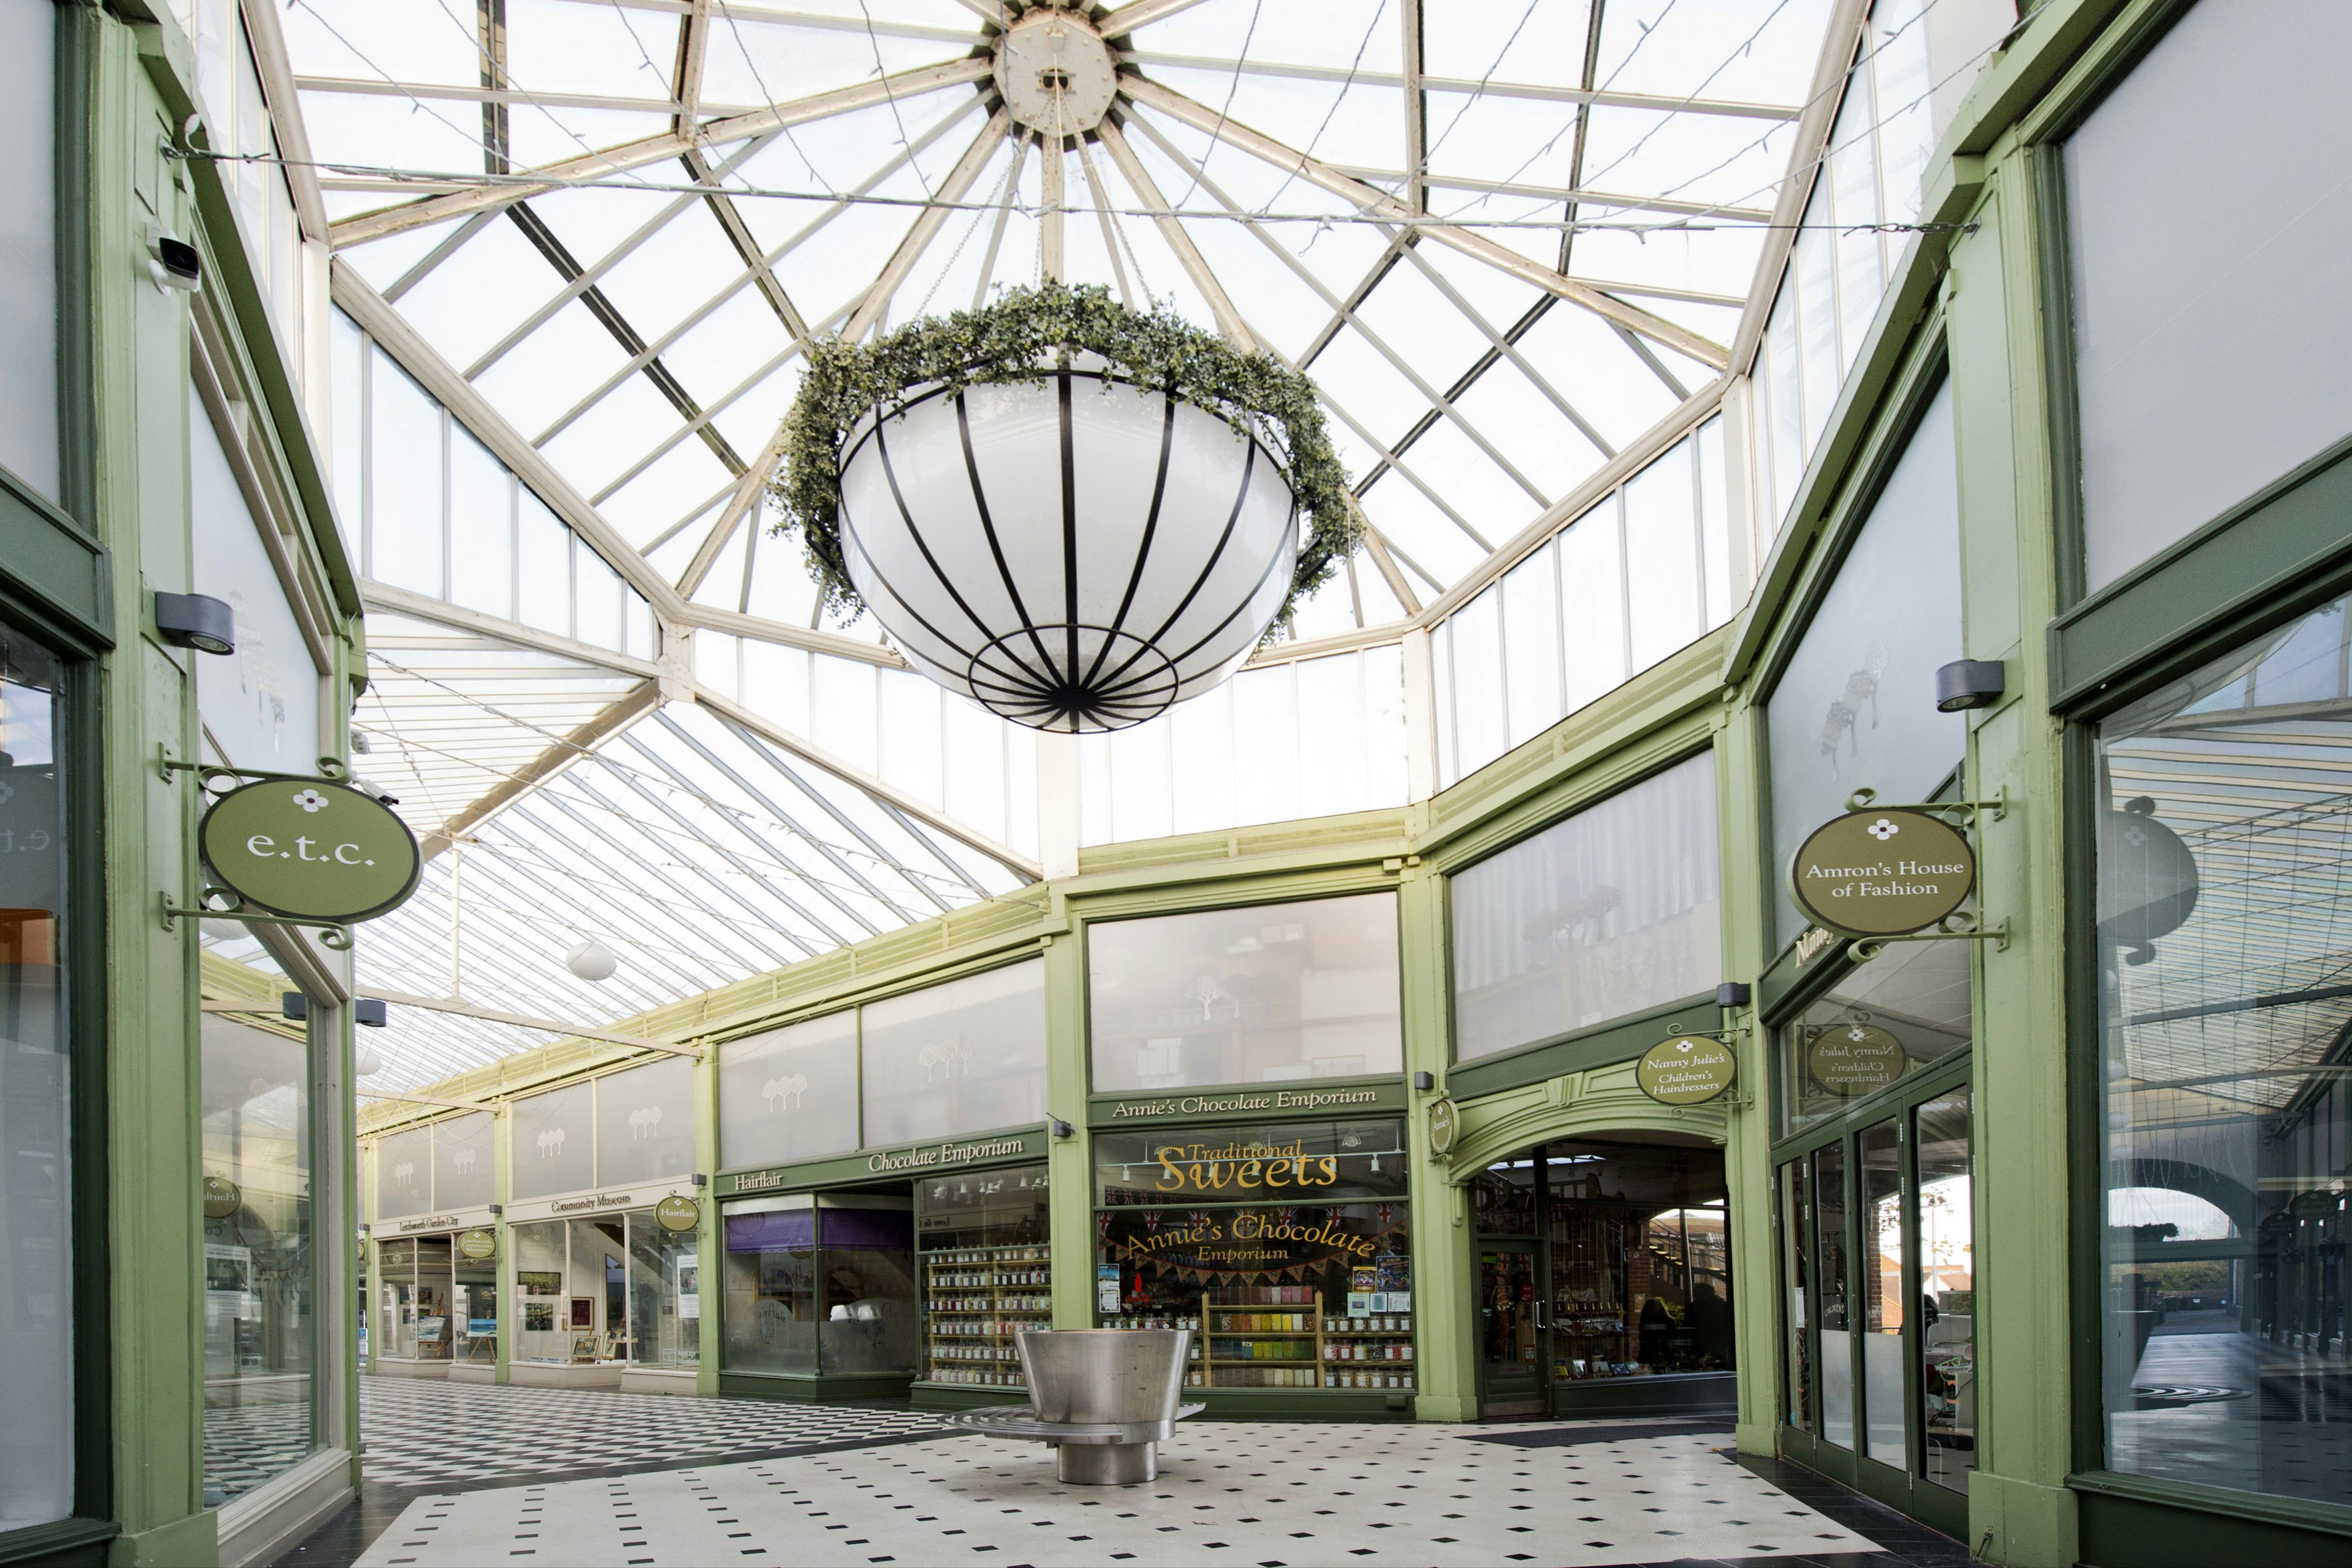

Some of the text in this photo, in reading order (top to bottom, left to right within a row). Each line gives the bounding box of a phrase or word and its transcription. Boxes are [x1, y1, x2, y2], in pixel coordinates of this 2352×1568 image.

[247, 835, 375, 866] e.t.c.
[1805, 861, 1964, 879] Amron's House
[1831, 881, 1939, 898] of Fashion
[1647, 1053, 1725, 1068] Nanny Julie's
[1659, 1070, 1713, 1083] Children's
[1654, 1083, 1720, 1094] Hairdressers
[1112, 1089, 1377, 1118] Annie's Chocolate Emporium
[868, 1139, 1023, 1172] Chocolate Emporium
[1187, 1139, 1303, 1161] Traditional
[1155, 1147, 1337, 1192] Sweets
[734, 1171, 782, 1191] Hairflair
[551, 1194, 631, 1213] Community Museum
[661, 1208, 695, 1218] Hairflair
[1128, 1215, 1375, 1260] Annie's Chocolate
[1198, 1245, 1289, 1264] Emporium
